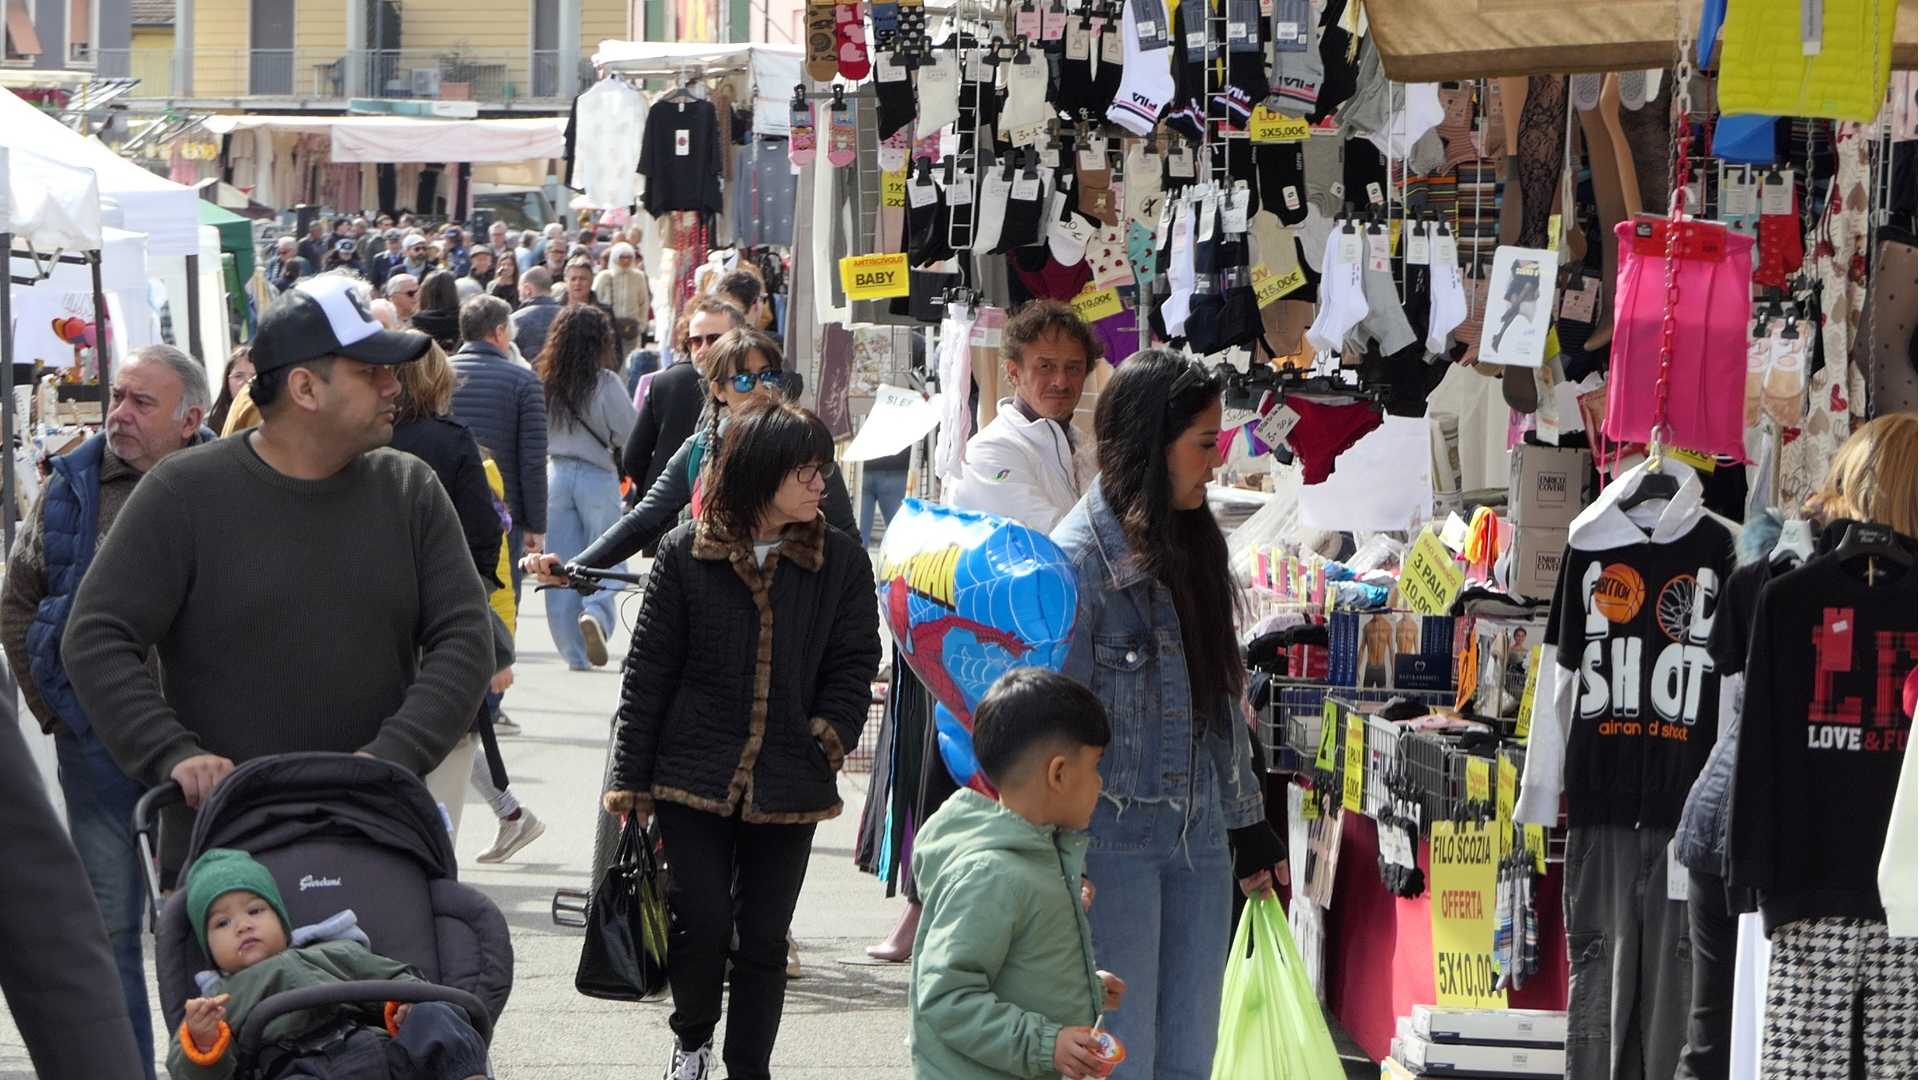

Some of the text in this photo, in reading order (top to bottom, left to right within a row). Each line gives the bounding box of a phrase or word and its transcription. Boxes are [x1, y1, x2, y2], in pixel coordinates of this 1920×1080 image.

[1132, 92, 1158, 112] FILA
[1260, 127, 1305, 138] 3X5,00€
[855, 271, 895, 286] BABY
[1413, 553, 1424, 569] 3
[1422, 564, 1446, 605] PAIA
[1580, 636, 1715, 725] SHOT
[1808, 725, 1862, 750] LOVE
[1865, 731, 1881, 751] &
[1433, 835, 1491, 864] FILO SCOZIA
[1441, 891, 1483, 920] OFFERTA
[1438, 951, 1503, 1006] 5X10,00
